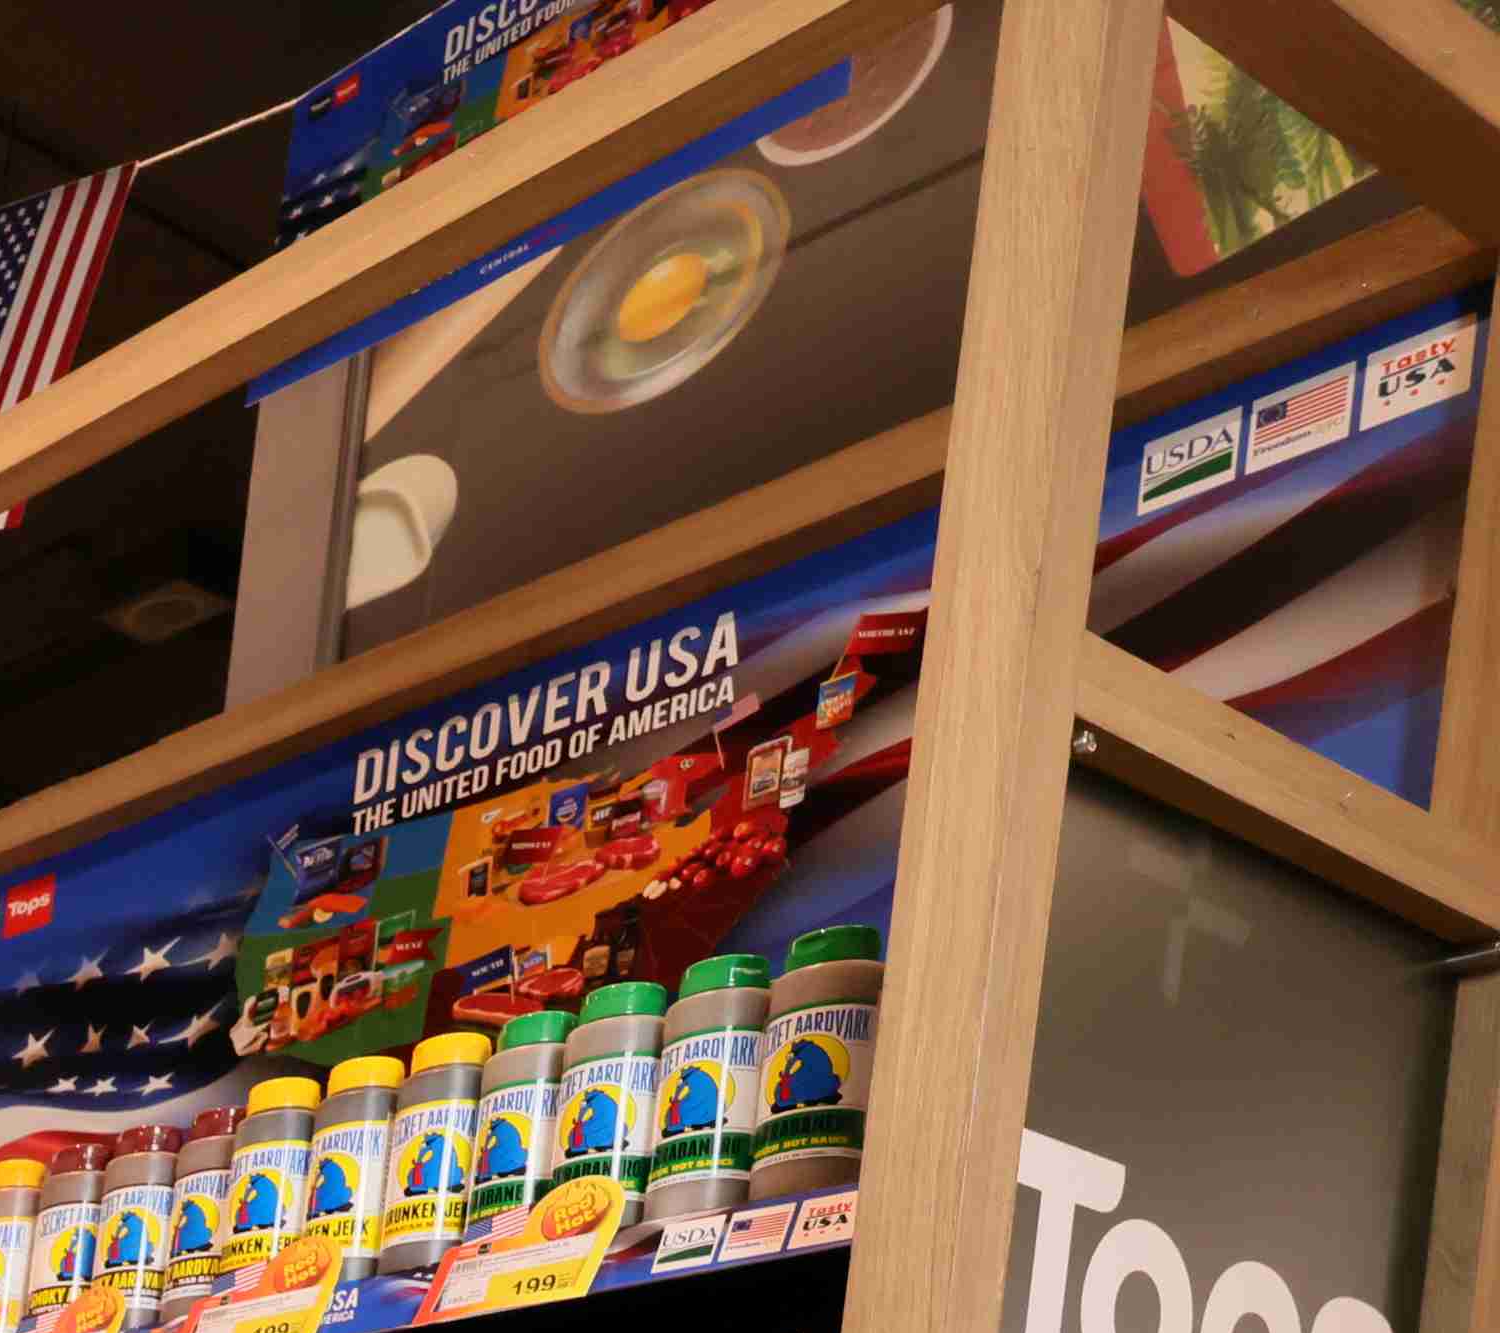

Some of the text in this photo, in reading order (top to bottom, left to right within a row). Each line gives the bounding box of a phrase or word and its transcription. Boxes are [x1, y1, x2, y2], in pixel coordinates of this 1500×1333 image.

[443, 12, 532, 85] THE UNITED
[1381, 337, 1457, 375] Tasty
[1378, 358, 1456, 399] USA
[1146, 428, 1234, 477] USDA
[352, 611, 739, 806] DISCOVER USA
[351, 674, 735, 837] THE UNITED FOOD OF AMERICA
[6, 892, 51, 919] Tops
[794, 1007, 873, 1038] AARDVARK
[661, 1224, 718, 1249] USDA
[802, 1213, 849, 1231] USA
[512, 1273, 558, 1297] 199
